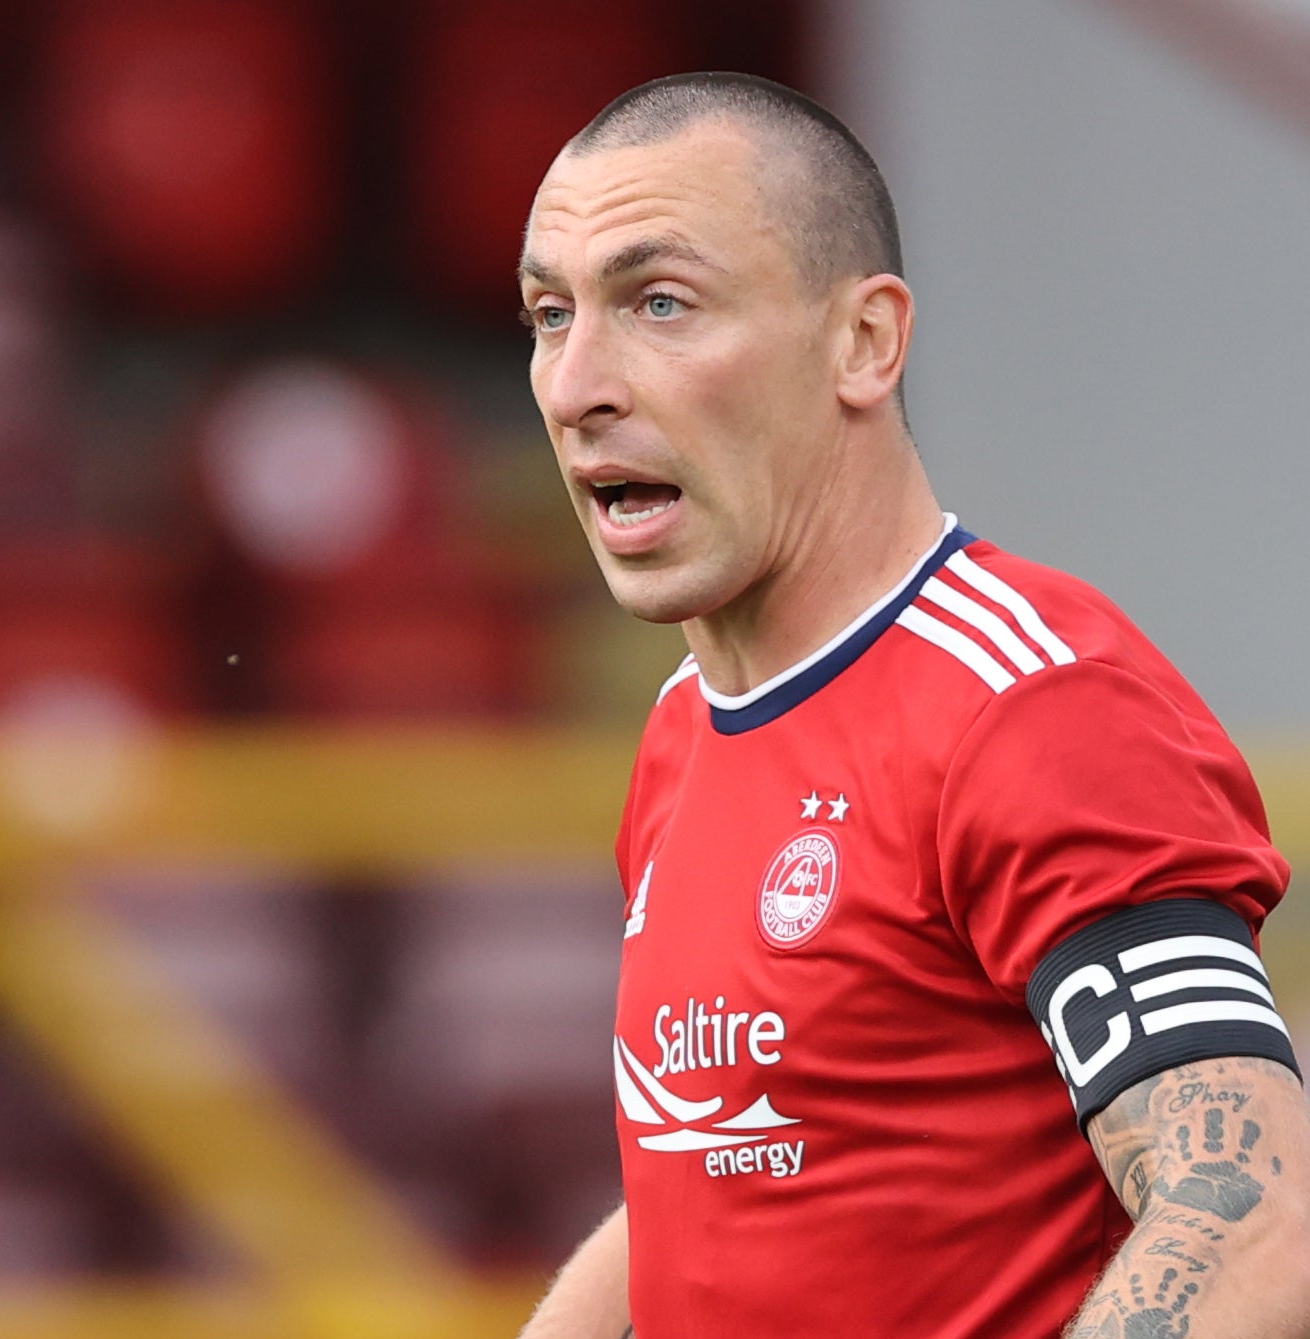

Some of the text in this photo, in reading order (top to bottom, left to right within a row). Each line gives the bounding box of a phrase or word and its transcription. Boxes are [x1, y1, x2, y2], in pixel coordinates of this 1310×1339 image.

[784, 839, 831, 866] ABERDEEN
[764, 890, 827, 936] FOOTBALL CLUB
[653, 996, 786, 1078] Saltire
[704, 1140, 804, 1178] energy
